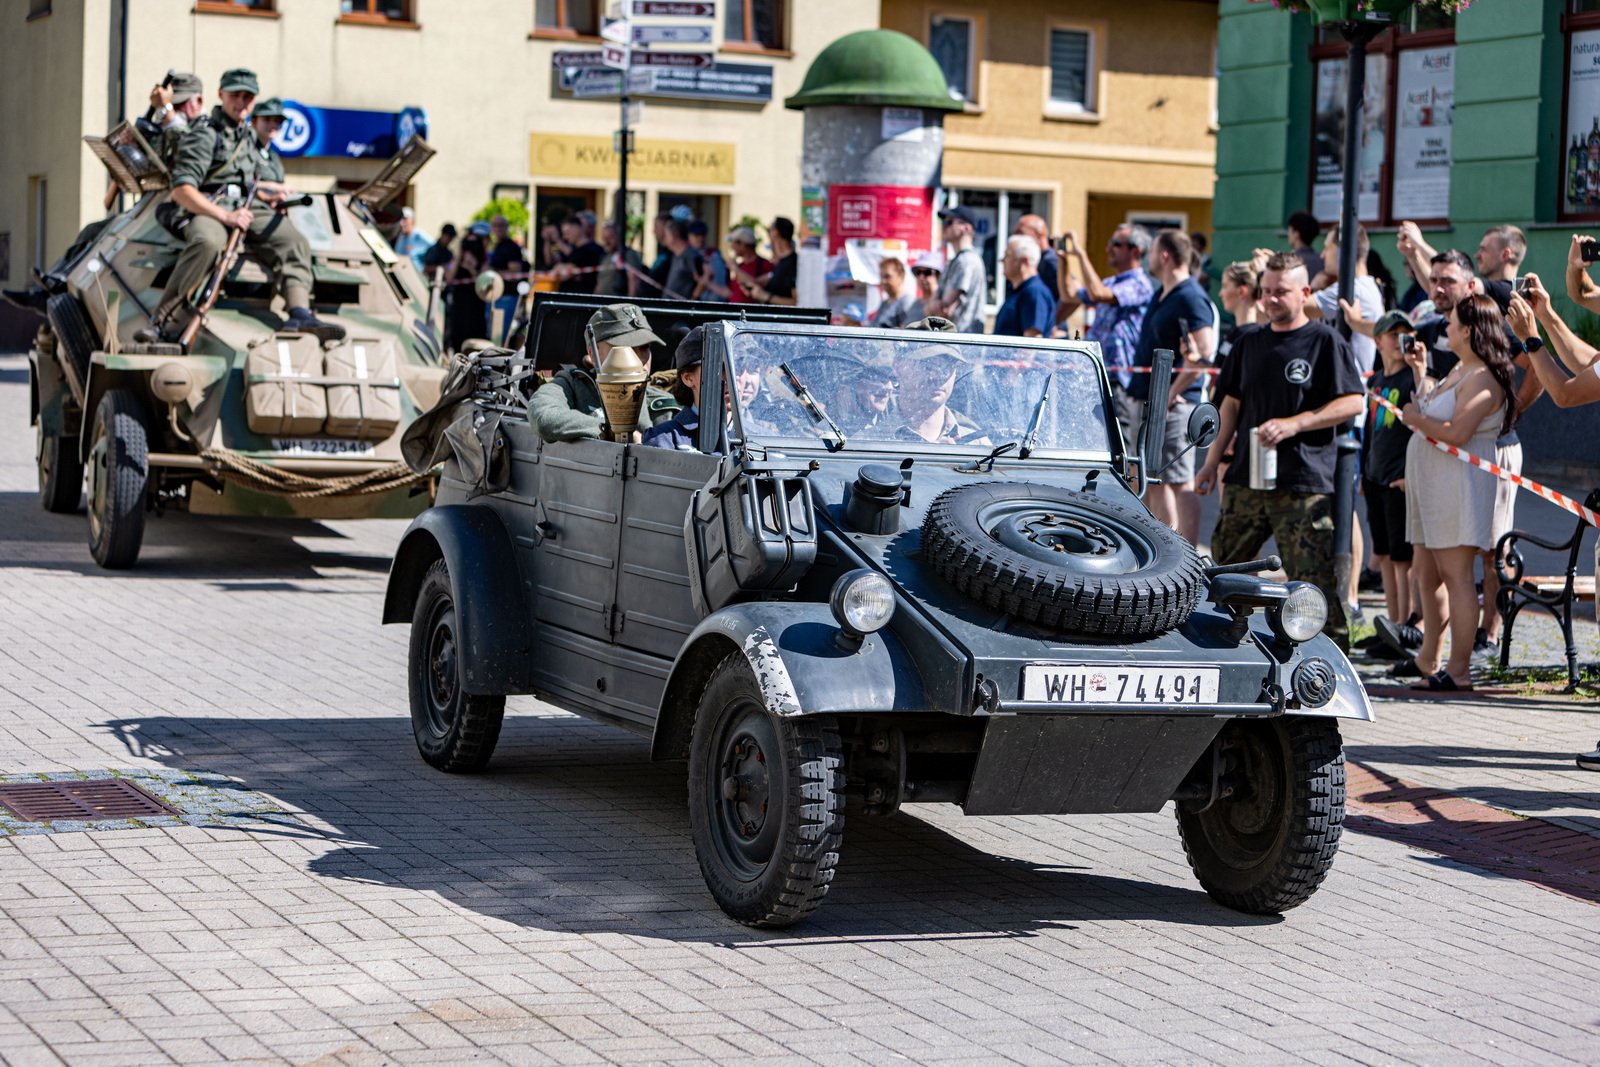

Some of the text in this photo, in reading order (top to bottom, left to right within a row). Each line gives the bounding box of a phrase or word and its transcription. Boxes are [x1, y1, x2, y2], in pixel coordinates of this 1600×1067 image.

[575, 144, 721, 168] KWICIARNIA
[1044, 674, 1086, 702] WH
[1117, 675, 1202, 703] 74491
